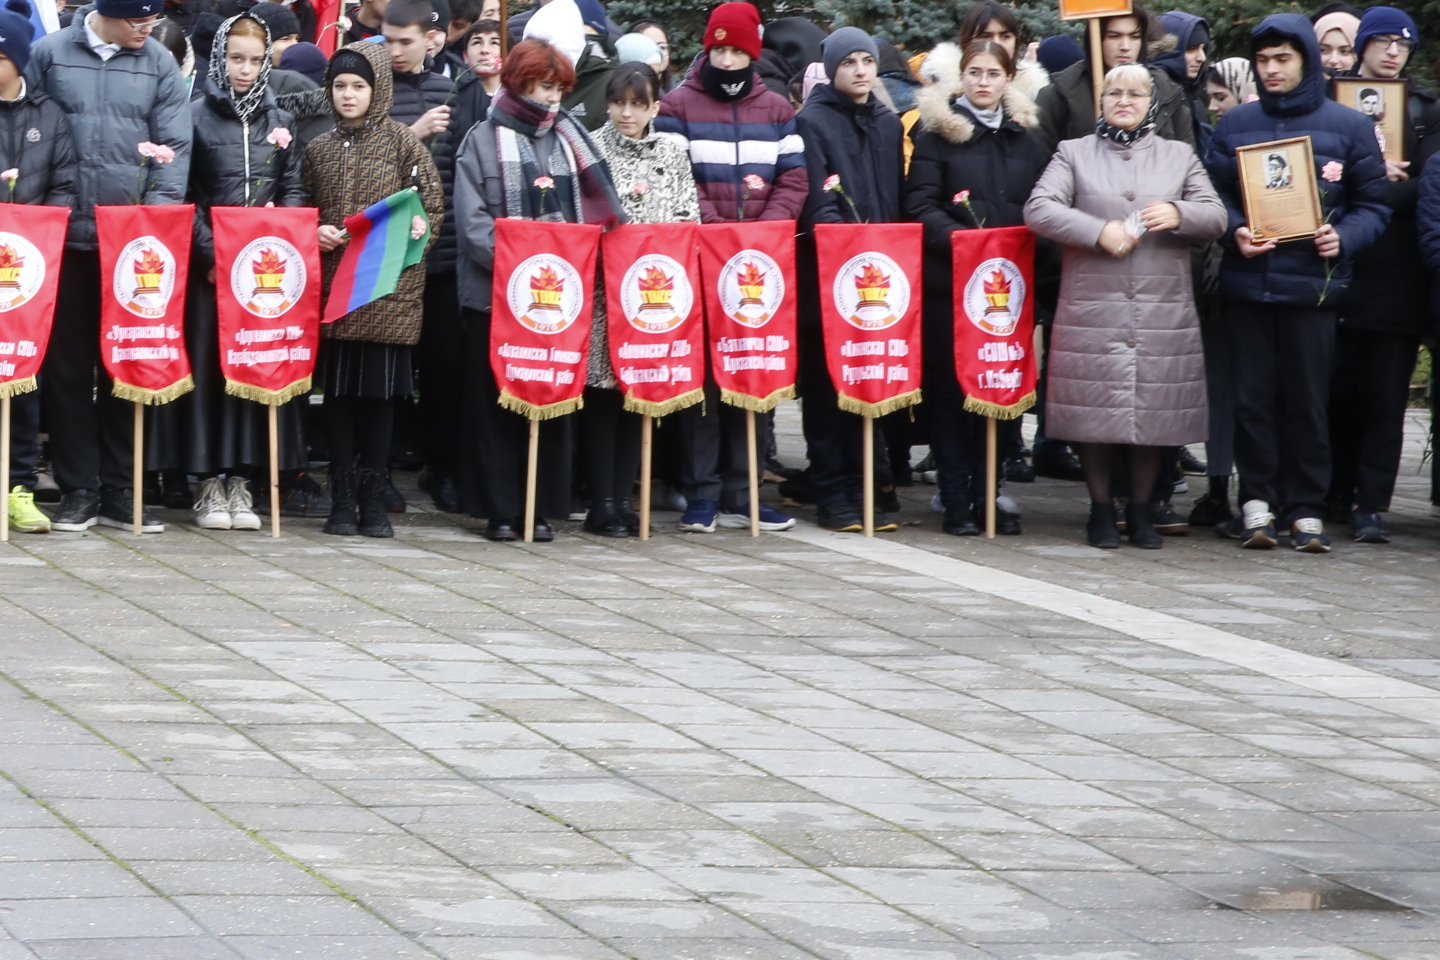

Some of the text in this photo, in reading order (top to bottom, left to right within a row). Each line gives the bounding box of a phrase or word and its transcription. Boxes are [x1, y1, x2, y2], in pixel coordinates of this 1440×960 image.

[531, 289, 562, 304] ТОКС
[533, 322, 559, 331] 1970
[644, 322, 669, 331] 1970
[17, 340, 38, 357] СОШ»
[765, 334, 790, 352] СОШ»
[887, 338, 909, 357] СОШ»
